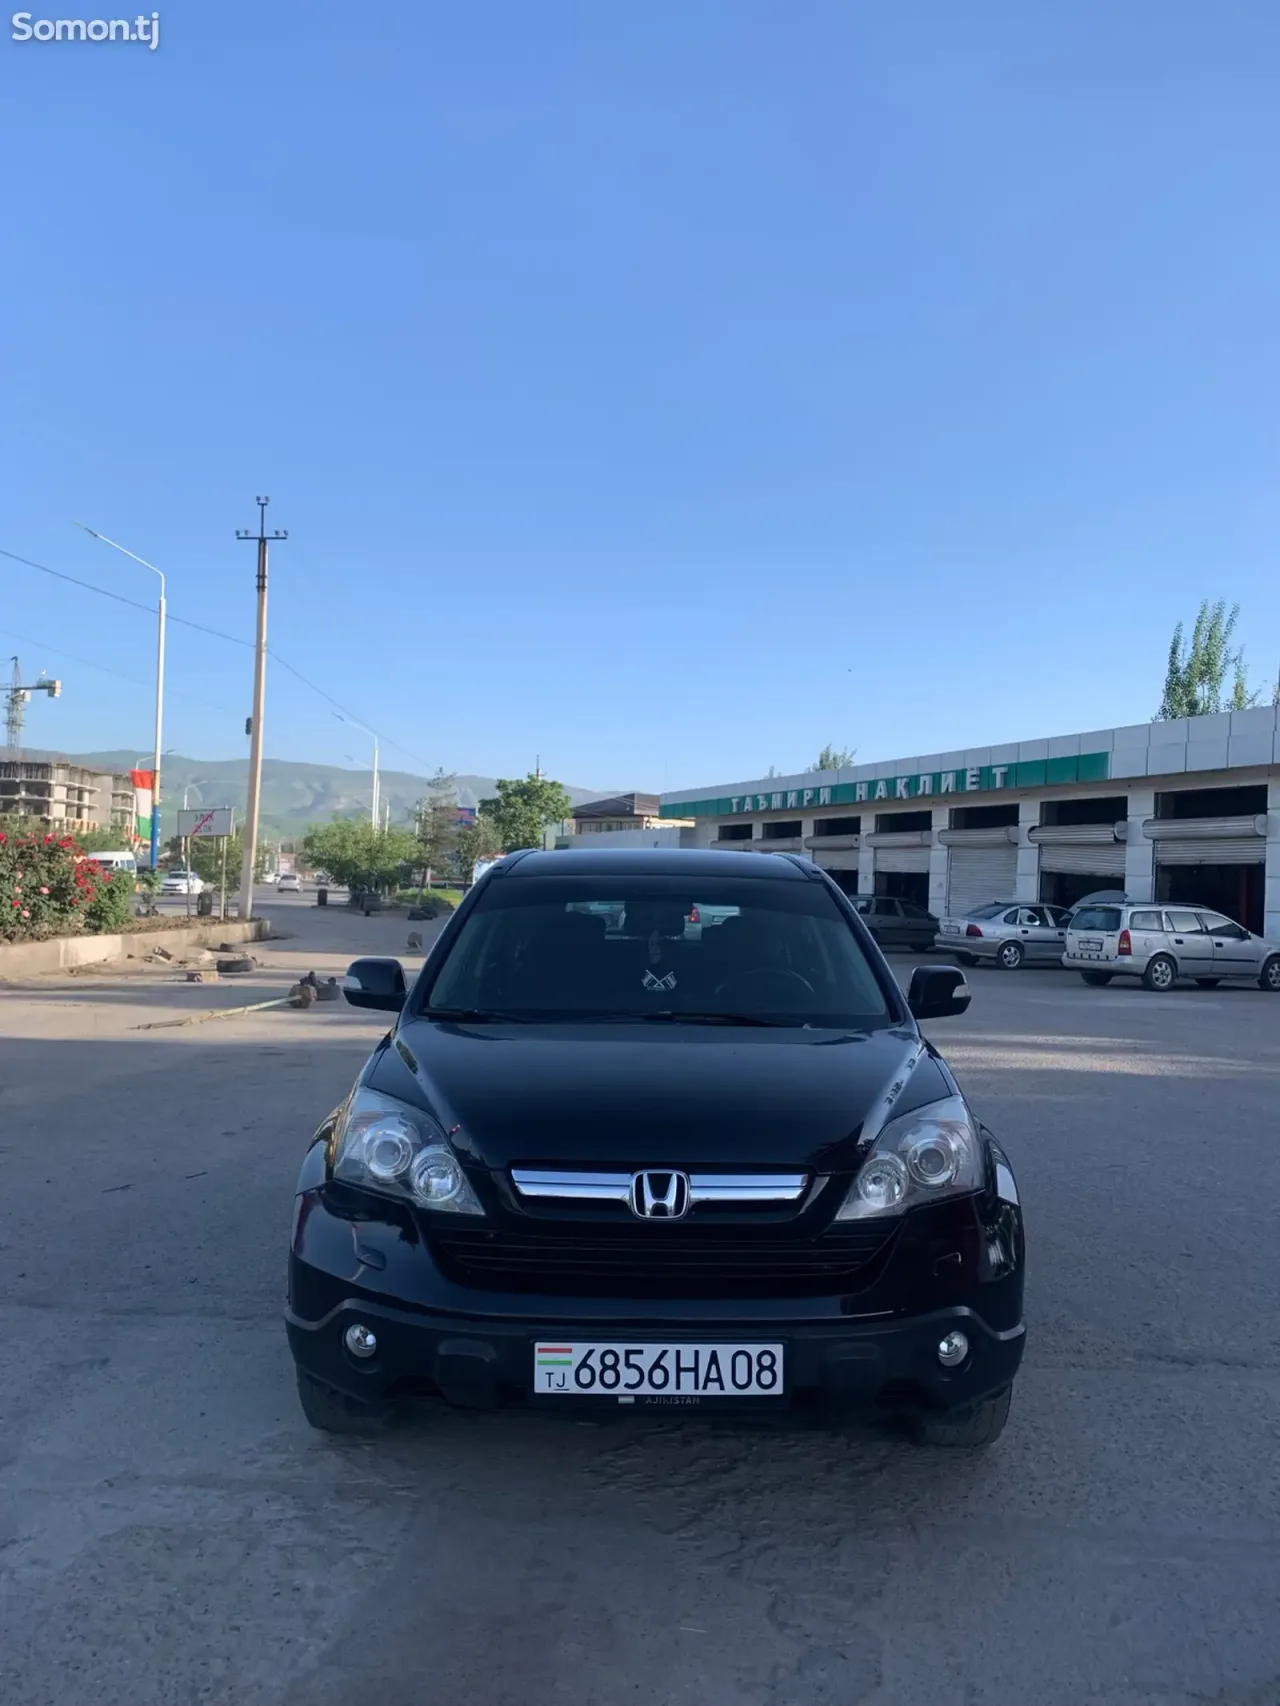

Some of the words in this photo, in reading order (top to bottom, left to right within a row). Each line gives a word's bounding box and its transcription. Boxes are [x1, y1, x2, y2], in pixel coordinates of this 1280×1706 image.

[731, 786, 832, 813] ТАЪМИРИ
[545, 1371, 567, 1389] TJ
[574, 1348, 777, 1391] 6856HA08
[639, 1396, 700, 1405] AJIKISTAN
